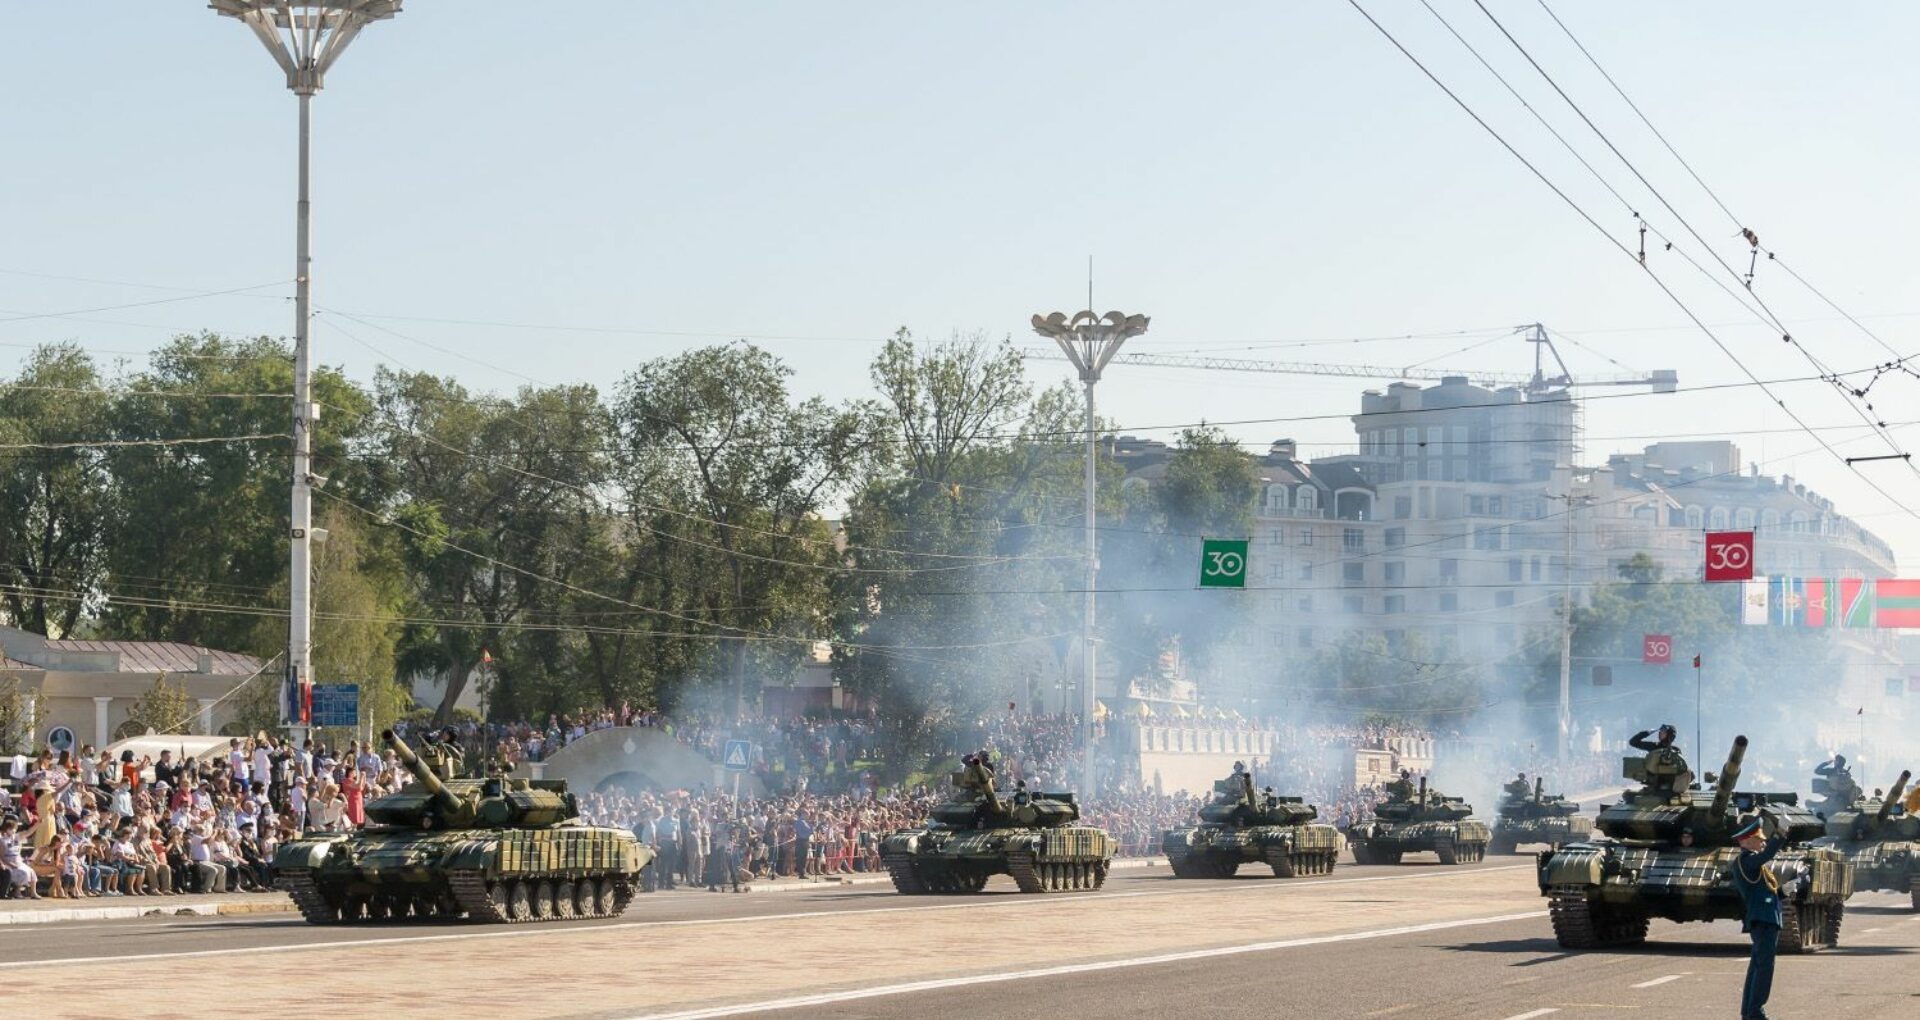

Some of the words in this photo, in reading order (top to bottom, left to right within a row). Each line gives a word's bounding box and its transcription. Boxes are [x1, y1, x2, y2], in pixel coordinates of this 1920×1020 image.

[1206, 552, 1243, 576] 30
[1710, 543, 1750, 570] 30
[1646, 641, 1669, 657] 30
